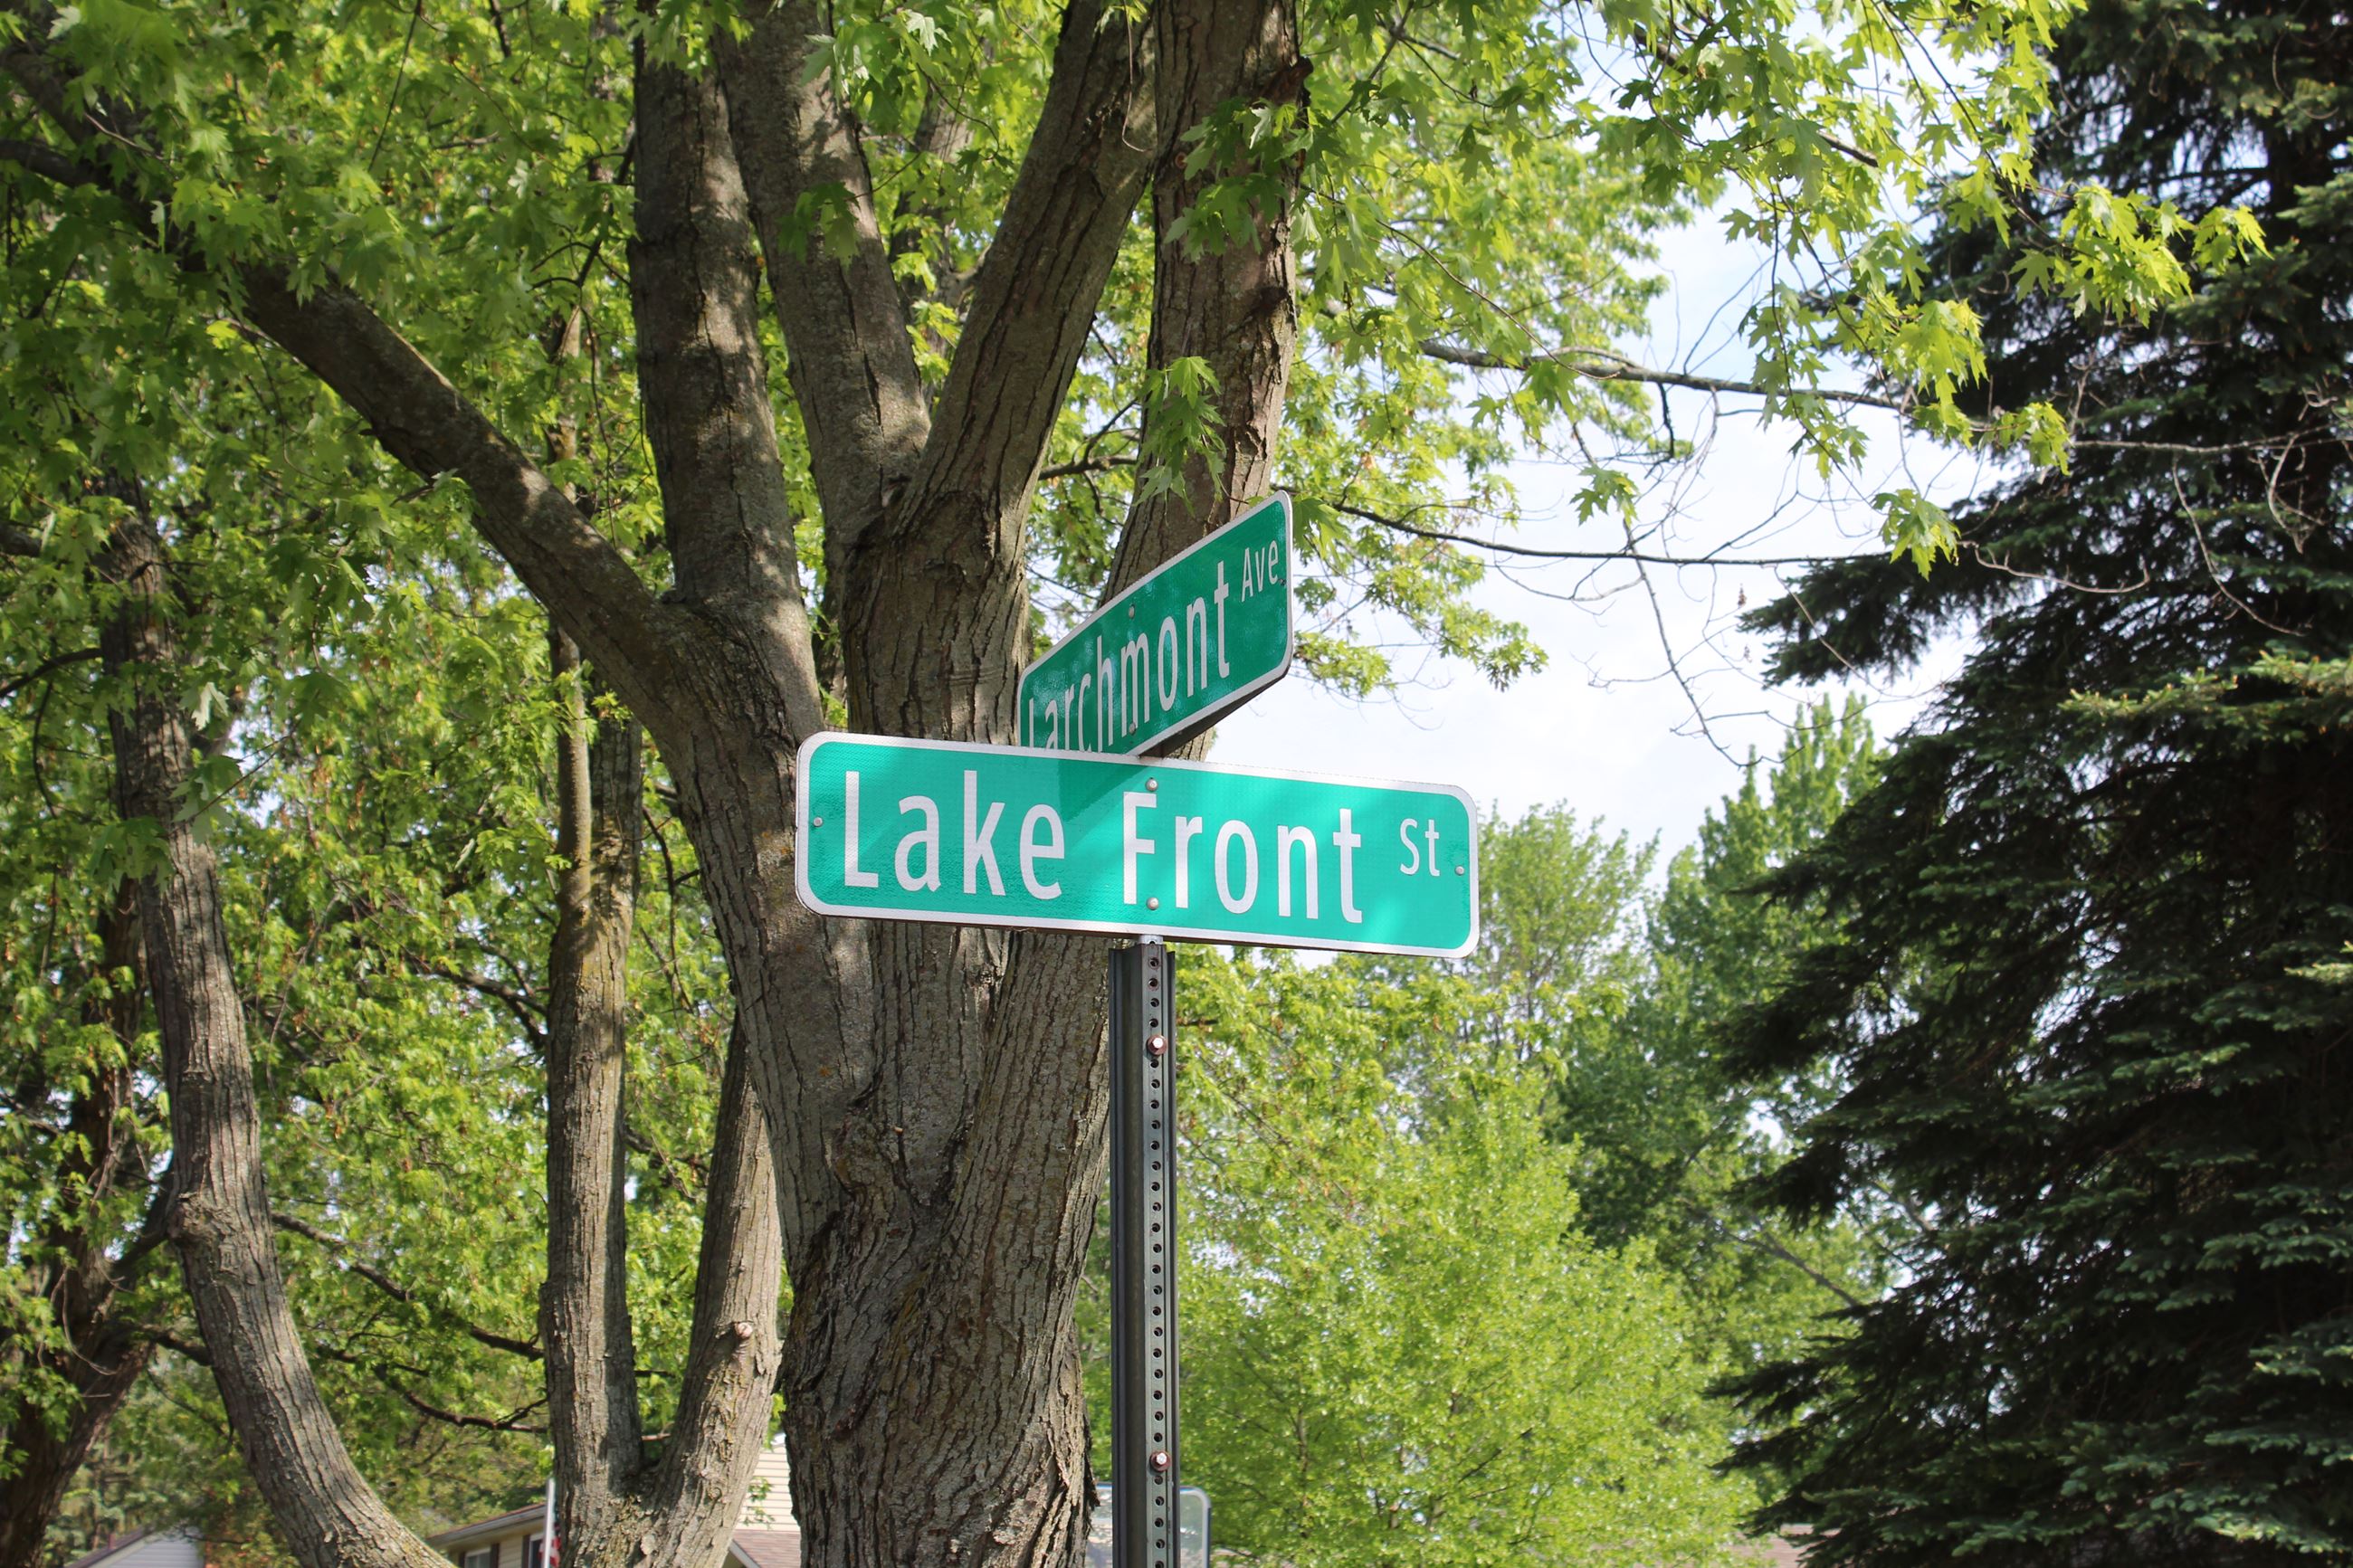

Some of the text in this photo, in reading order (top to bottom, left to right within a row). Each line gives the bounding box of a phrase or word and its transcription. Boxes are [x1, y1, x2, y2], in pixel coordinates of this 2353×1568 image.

[1243, 538, 1280, 603] Ave
[843, 770, 1441, 924] Lake Front St
